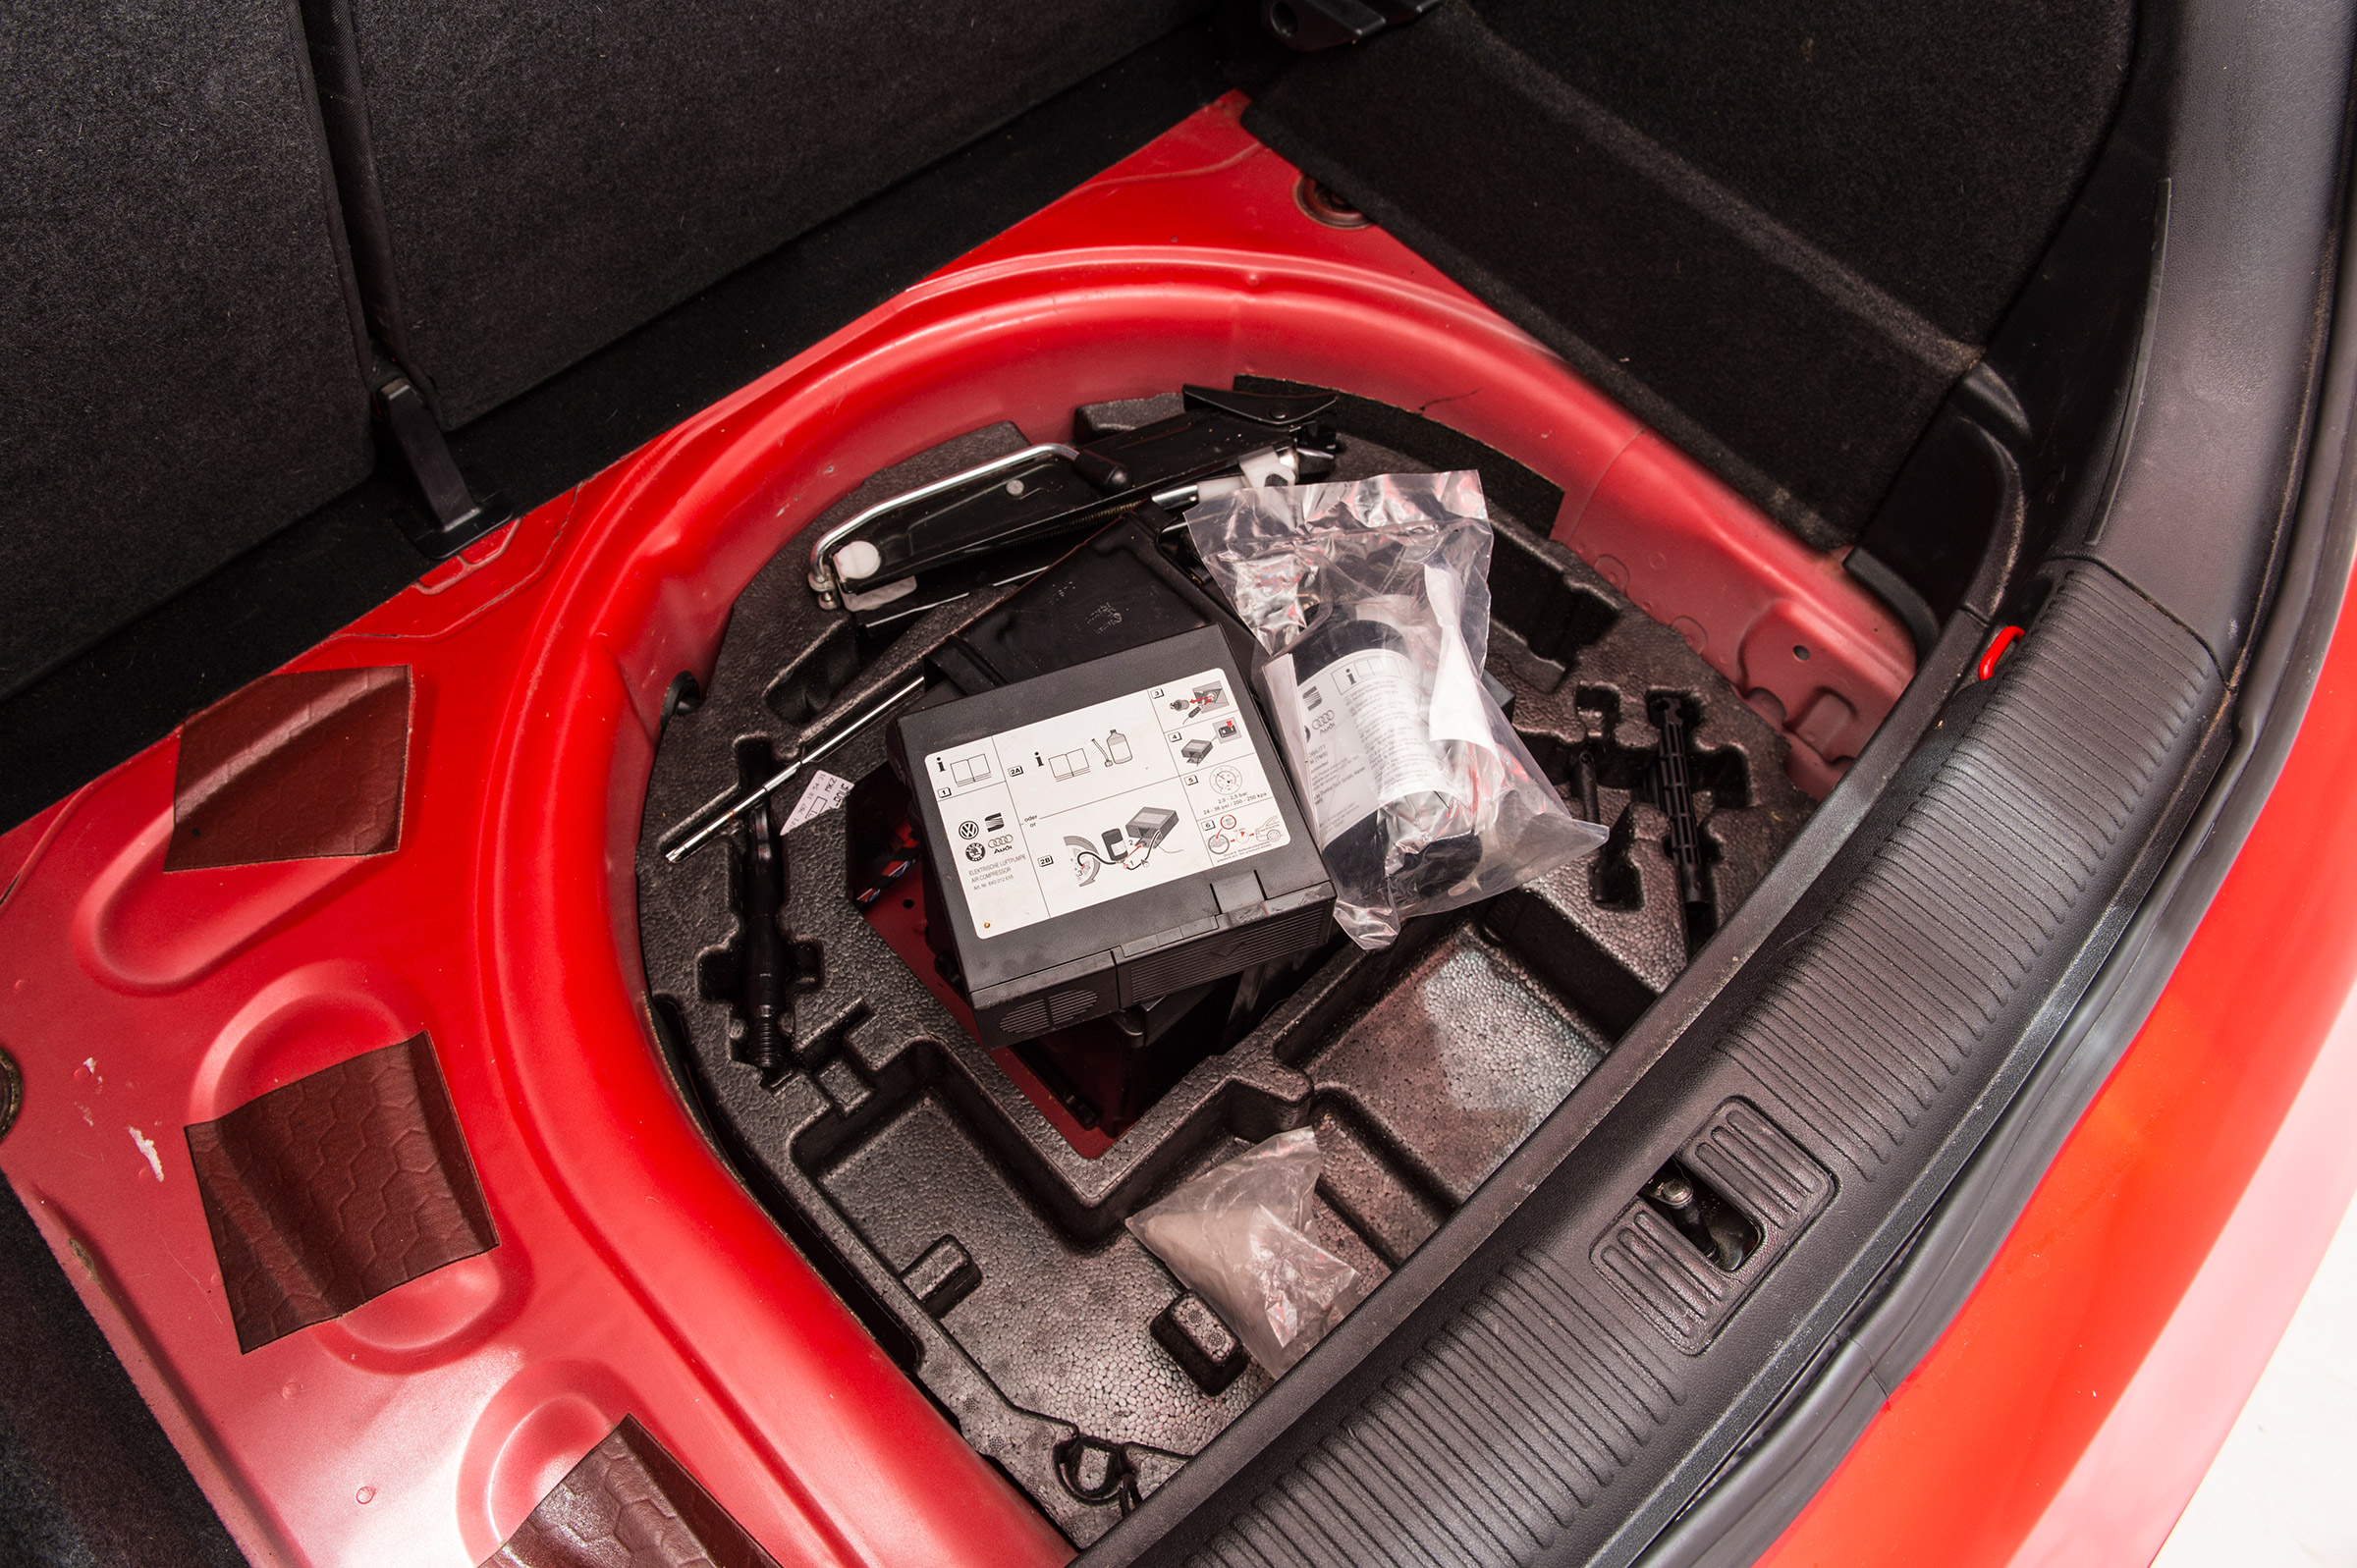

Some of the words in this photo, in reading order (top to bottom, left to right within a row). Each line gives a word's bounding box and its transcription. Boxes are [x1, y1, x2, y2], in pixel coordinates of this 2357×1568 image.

[1320, 723, 1335, 735] Audi
[994, 845, 1012, 854] Audi
[968, 862, 999, 875] ELEKTRISCHE
[999, 854, 1026, 866] LUFTPUMPE
[979, 866, 1011, 880] COMPRESSOR
